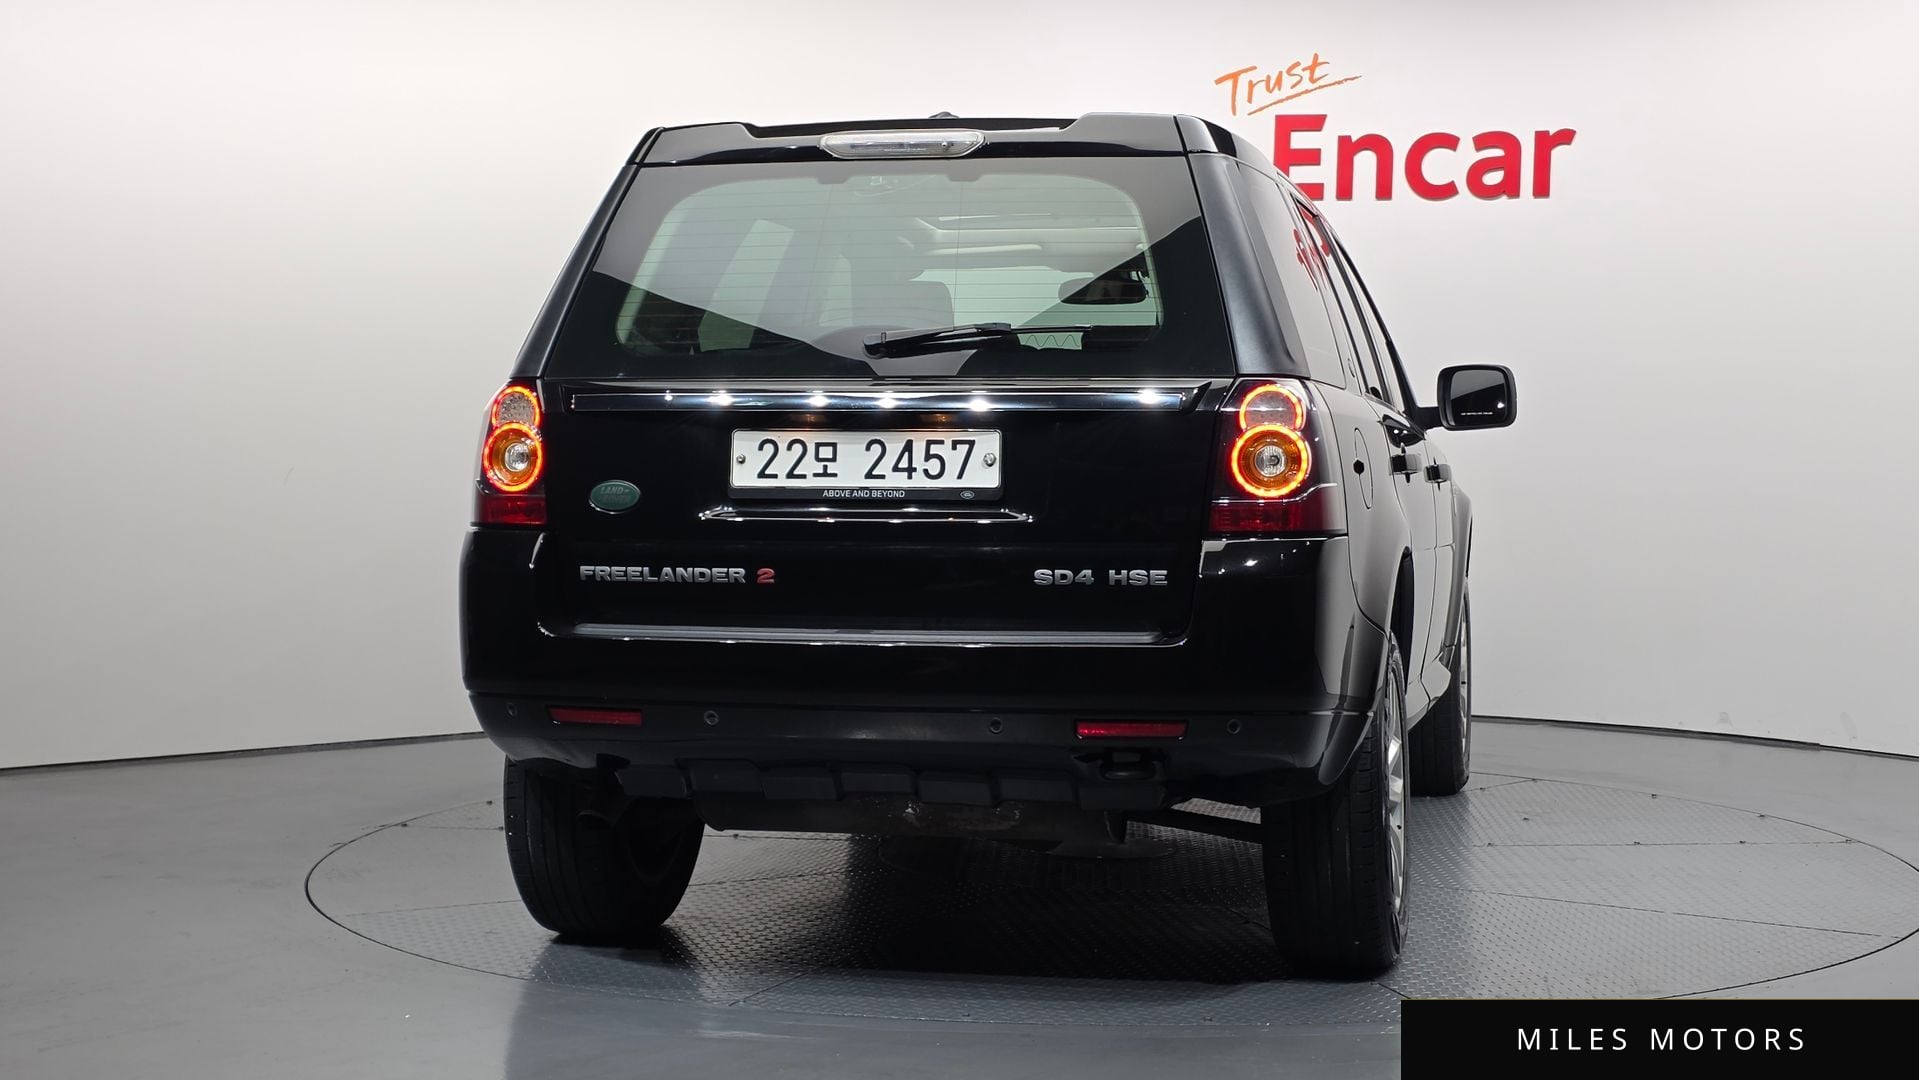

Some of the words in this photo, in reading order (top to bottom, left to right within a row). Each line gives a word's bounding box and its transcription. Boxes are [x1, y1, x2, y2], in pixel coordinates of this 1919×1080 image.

[1214, 52, 1330, 116] Trust
[1273, 114, 1577, 201] Encar
[757, 437, 838, 480] 22모
[863, 438, 976, 481] 2457
[822, 490, 851, 498] ABOVE
[852, 490, 870, 498] AND
[871, 490, 905, 498] BEYOND
[579, 565, 746, 584] FREELANDER
[756, 567, 775, 584] 2
[1033, 569, 1094, 586] SD4
[1108, 569, 1168, 586] HSE
